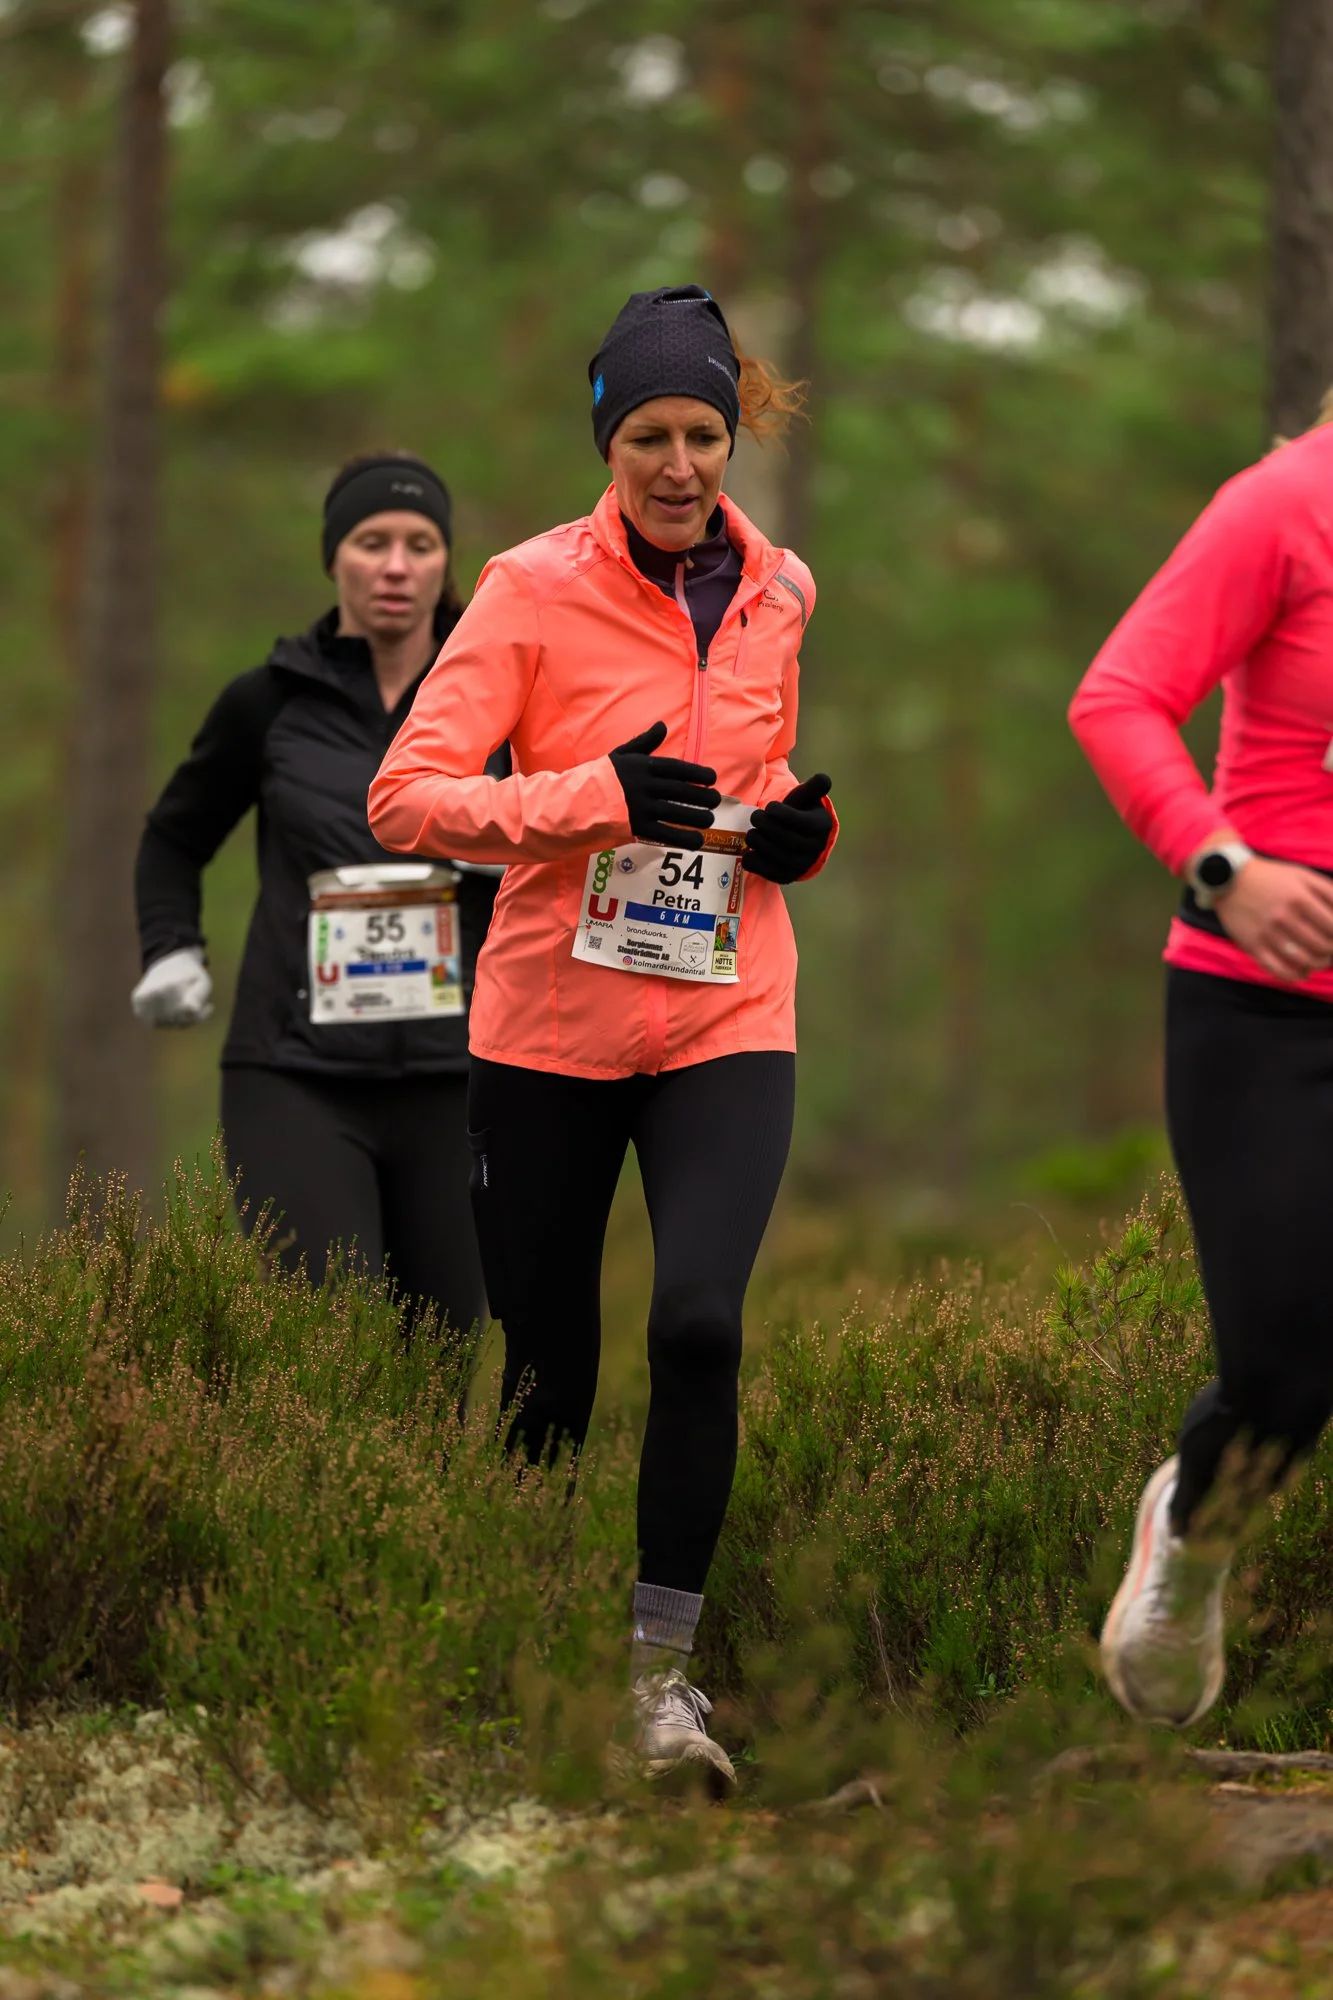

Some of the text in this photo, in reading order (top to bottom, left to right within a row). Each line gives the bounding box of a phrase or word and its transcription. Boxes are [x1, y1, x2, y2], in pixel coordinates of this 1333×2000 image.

[658, 851, 704, 890] 54
[652, 889, 701, 911] Petra
[660, 911, 666, 920] 6
[366, 913, 406, 945] 55
[585, 919, 614, 930] UMARA
[661, 953, 670, 961] AB
[633, 959, 706, 975] kolmardsrundantrail
